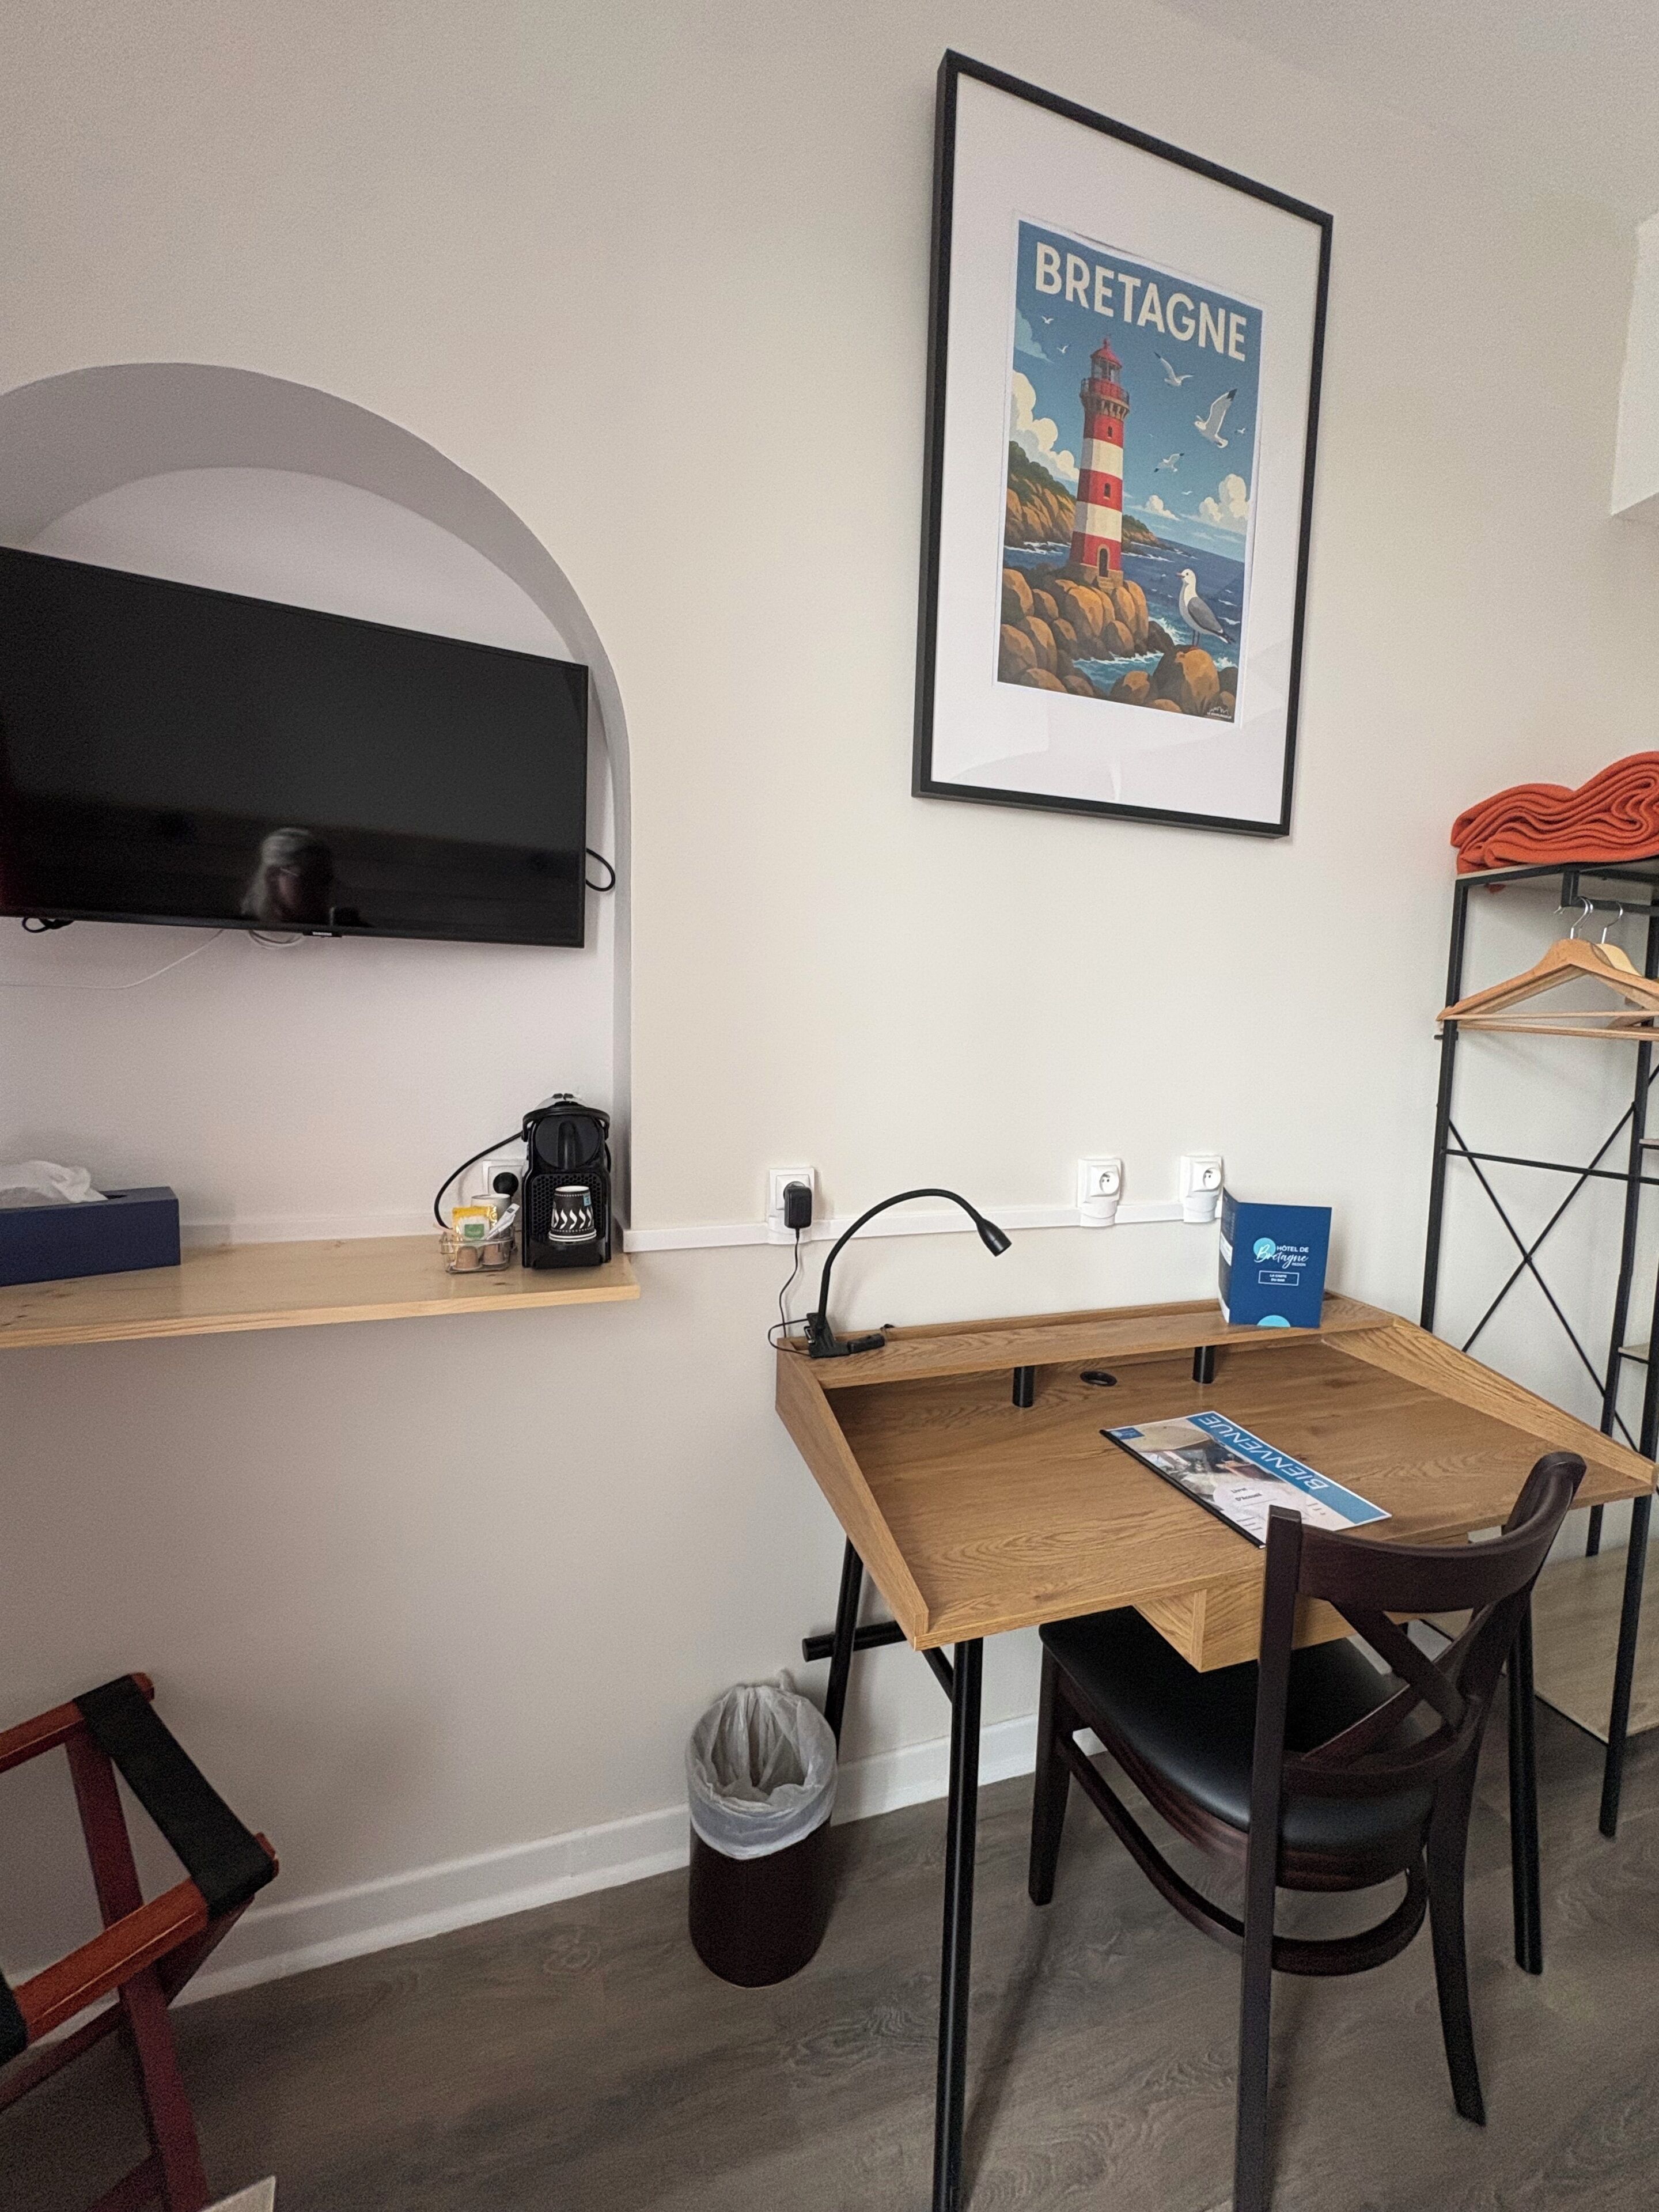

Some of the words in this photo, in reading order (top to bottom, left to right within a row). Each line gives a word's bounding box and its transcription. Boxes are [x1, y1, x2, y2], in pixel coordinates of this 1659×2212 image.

[1035, 241, 1247, 362] BRETAGNE
[1253, 1244, 1309, 1269] Bretagne
[1198, 1415, 1330, 1490] BIENVENUE
